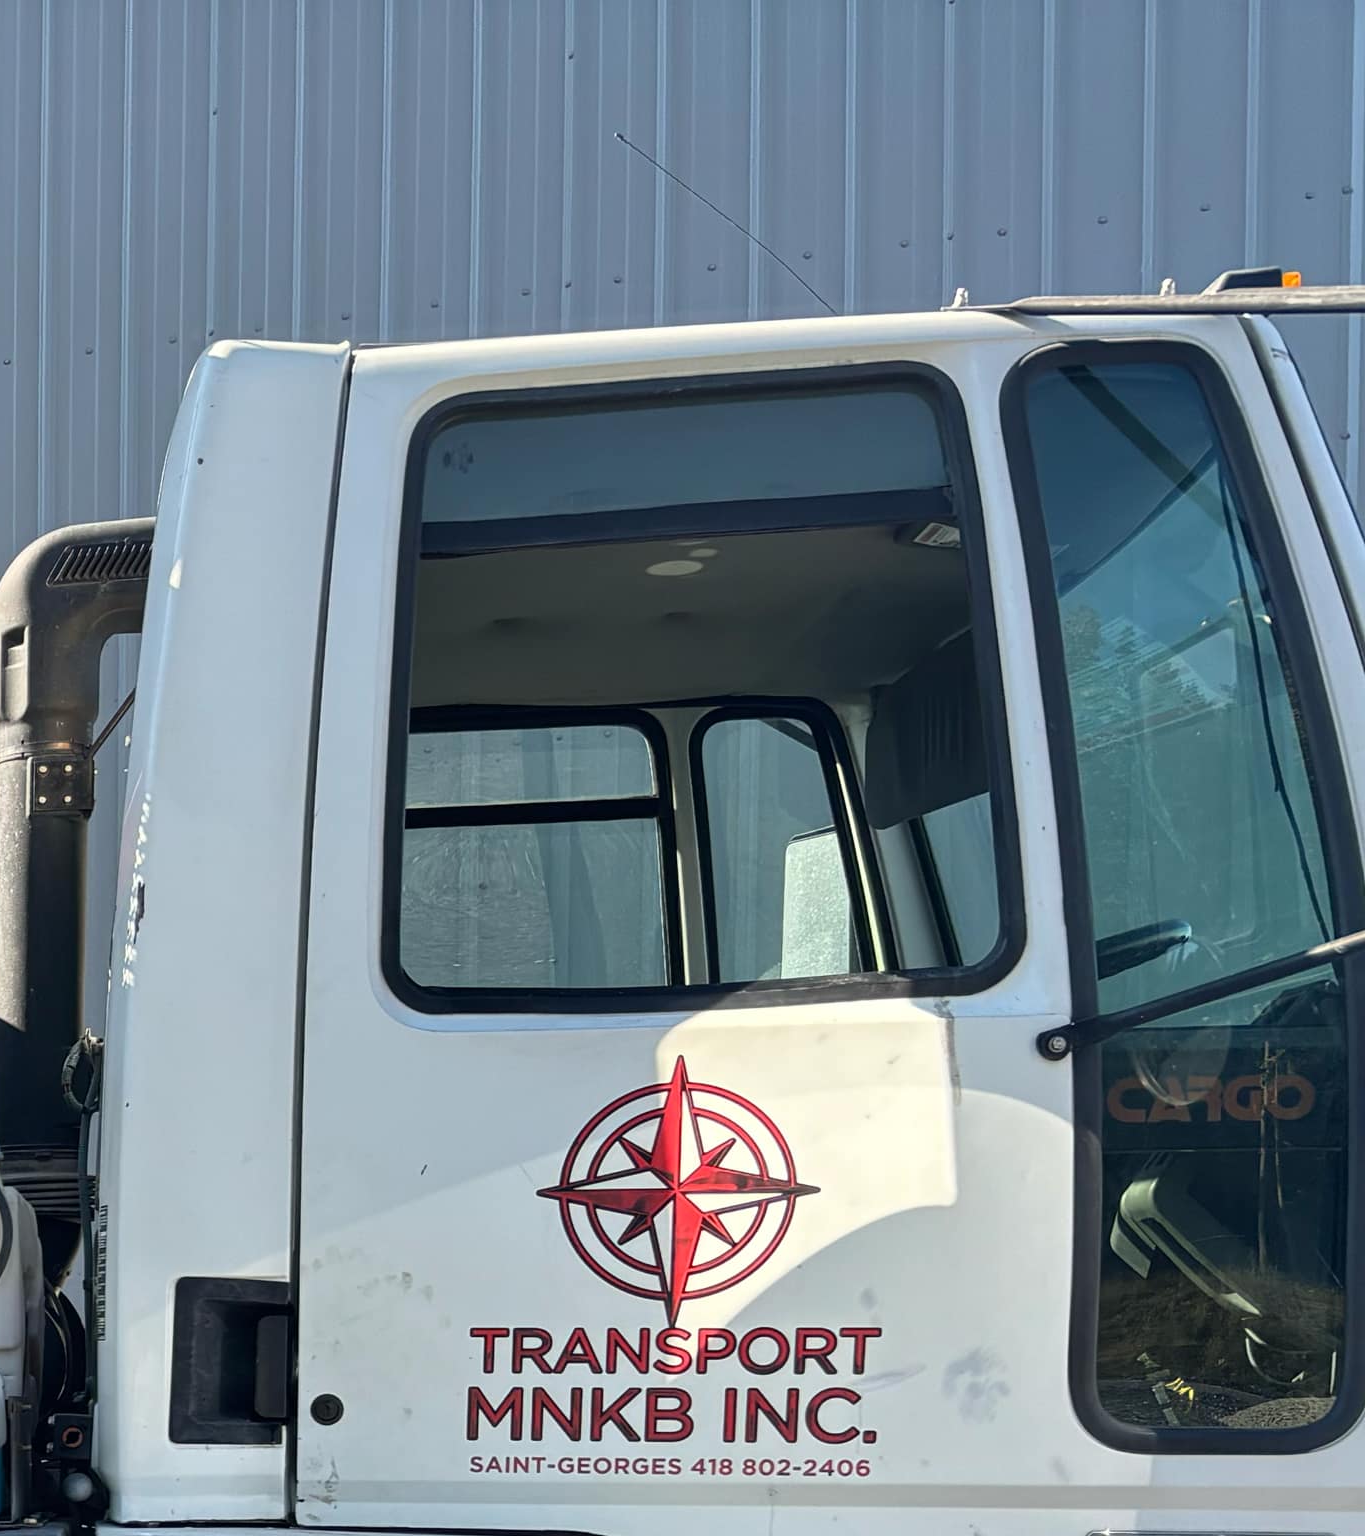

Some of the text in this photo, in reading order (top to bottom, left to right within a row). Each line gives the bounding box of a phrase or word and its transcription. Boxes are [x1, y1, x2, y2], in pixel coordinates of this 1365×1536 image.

[1106, 1074, 1316, 1123] CARGO
[469, 1327, 882, 1376] TRANSPORT
[466, 1386, 878, 1445] MNKB INC.
[469, 1456, 872, 1478] SAINT-GEORGES 418 802-2406
